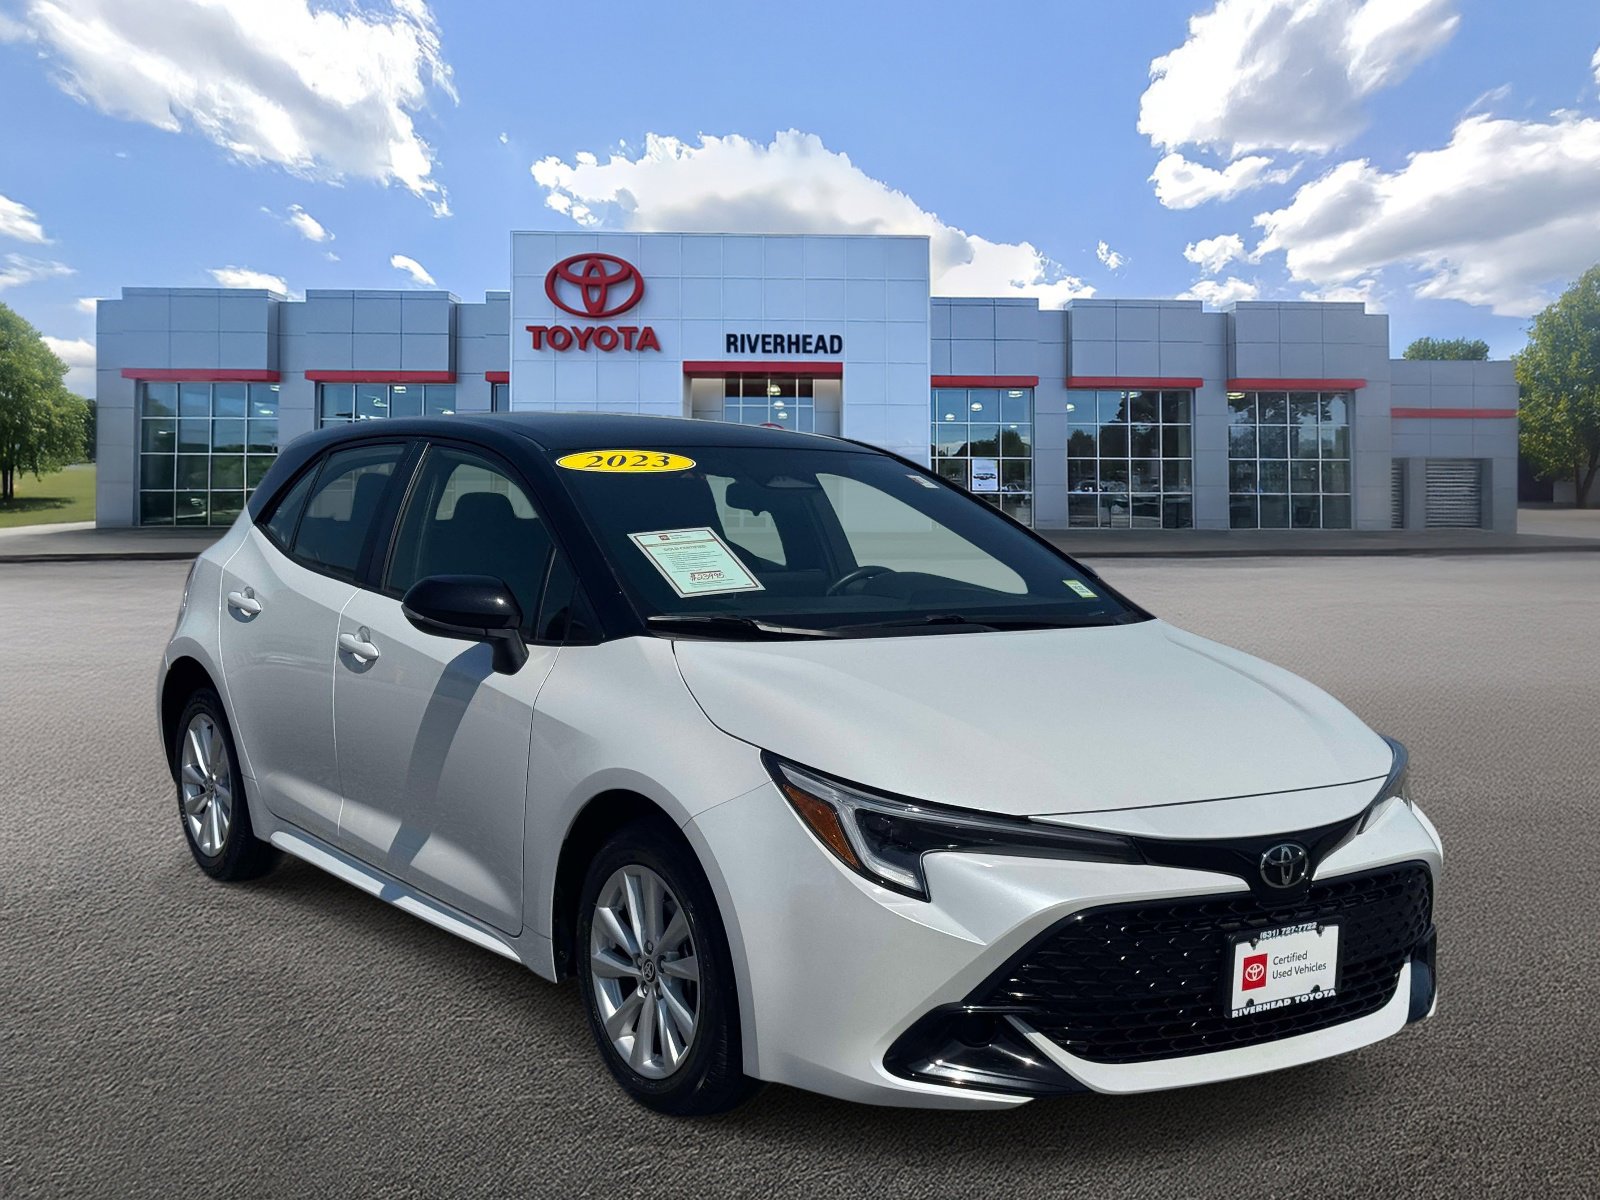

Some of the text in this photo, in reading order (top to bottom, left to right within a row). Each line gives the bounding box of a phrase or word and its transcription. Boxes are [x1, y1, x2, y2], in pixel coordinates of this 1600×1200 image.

[526, 325, 661, 352] TOYOTA
[726, 333, 843, 354] RIVERHEAD
[586, 454, 671, 468] 2023
[1272, 951, 1308, 966] Certified
[1272, 962, 1327, 979] Used Vehicles
[1231, 989, 1336, 1018] RIVERHEAD TOYOTA
